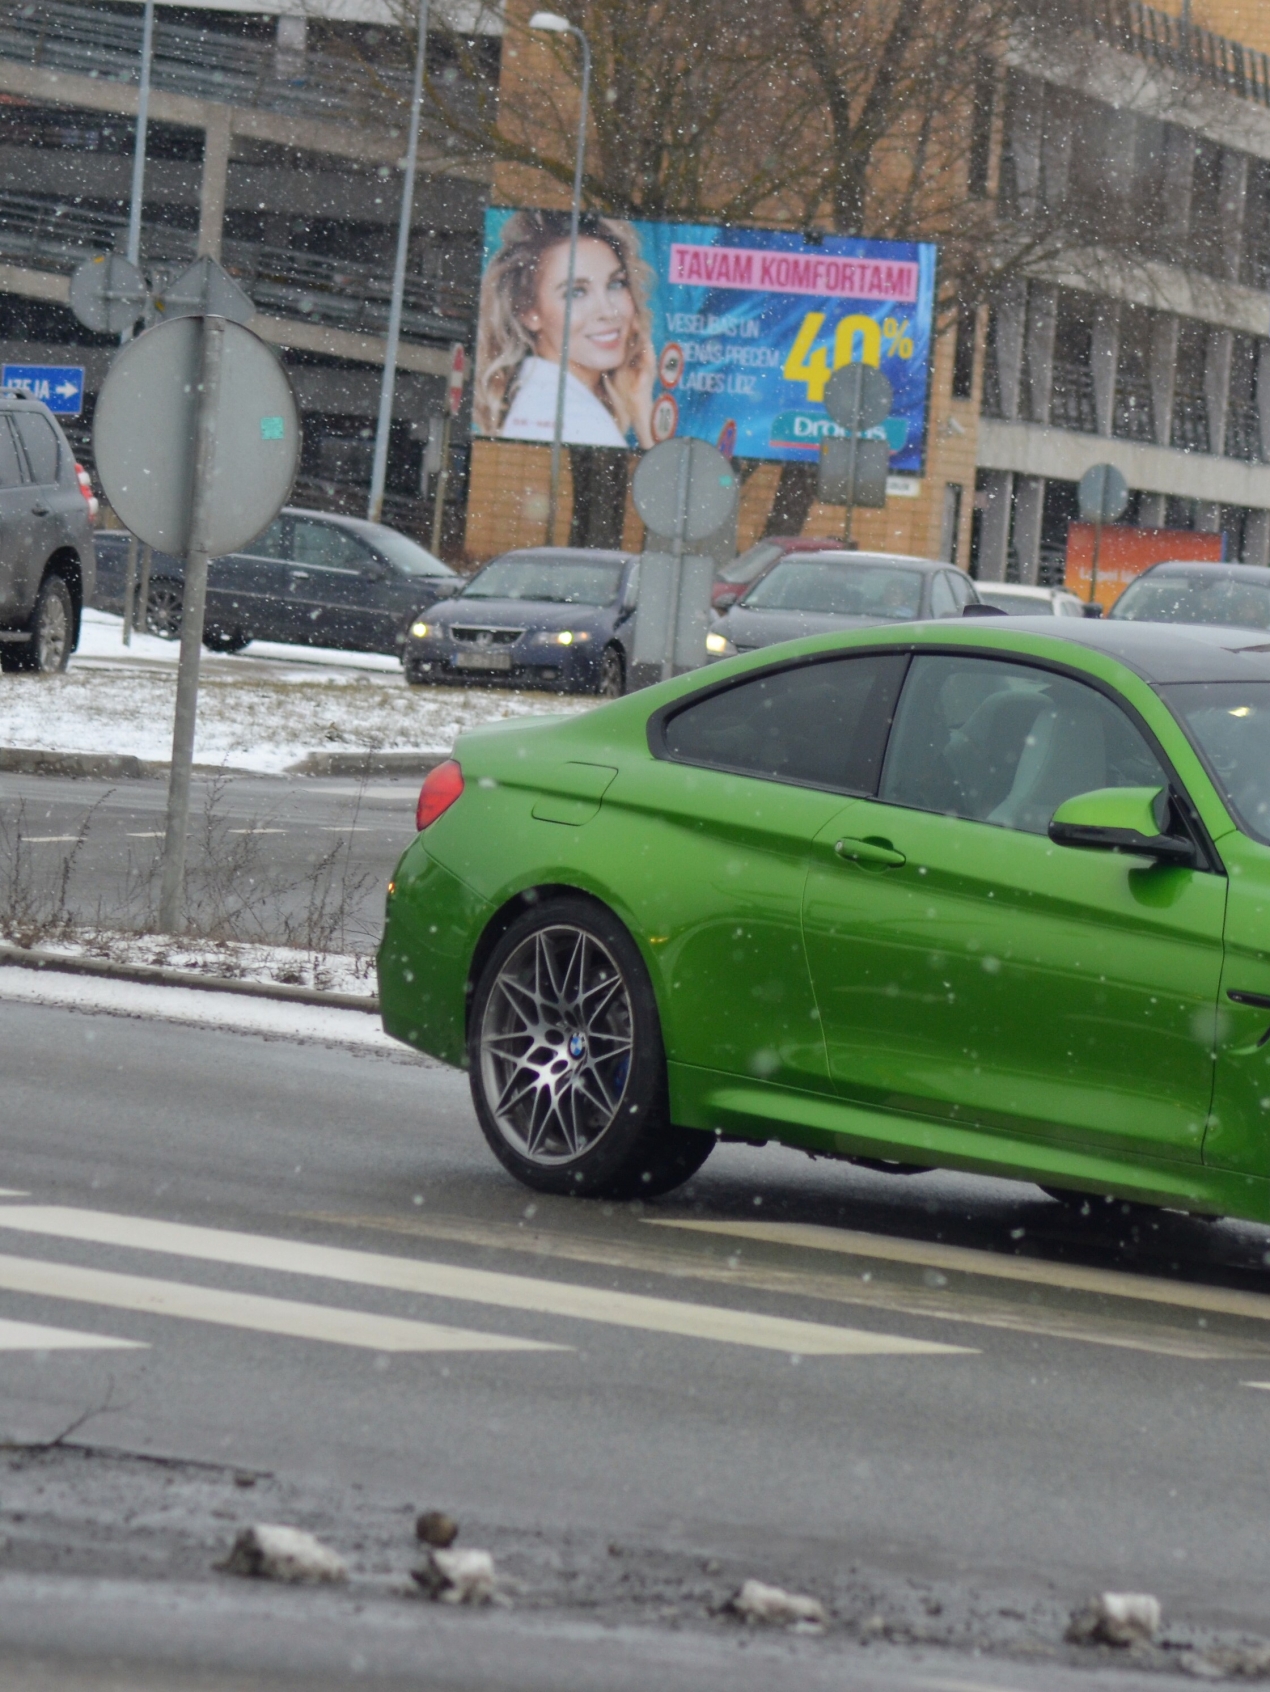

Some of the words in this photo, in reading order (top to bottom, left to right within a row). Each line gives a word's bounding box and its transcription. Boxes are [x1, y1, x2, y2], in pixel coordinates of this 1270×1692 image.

[675, 250, 753, 284] TAVAM
[761, 256, 912, 297] KOMFORTAM!
[740, 319, 760, 338] UN
